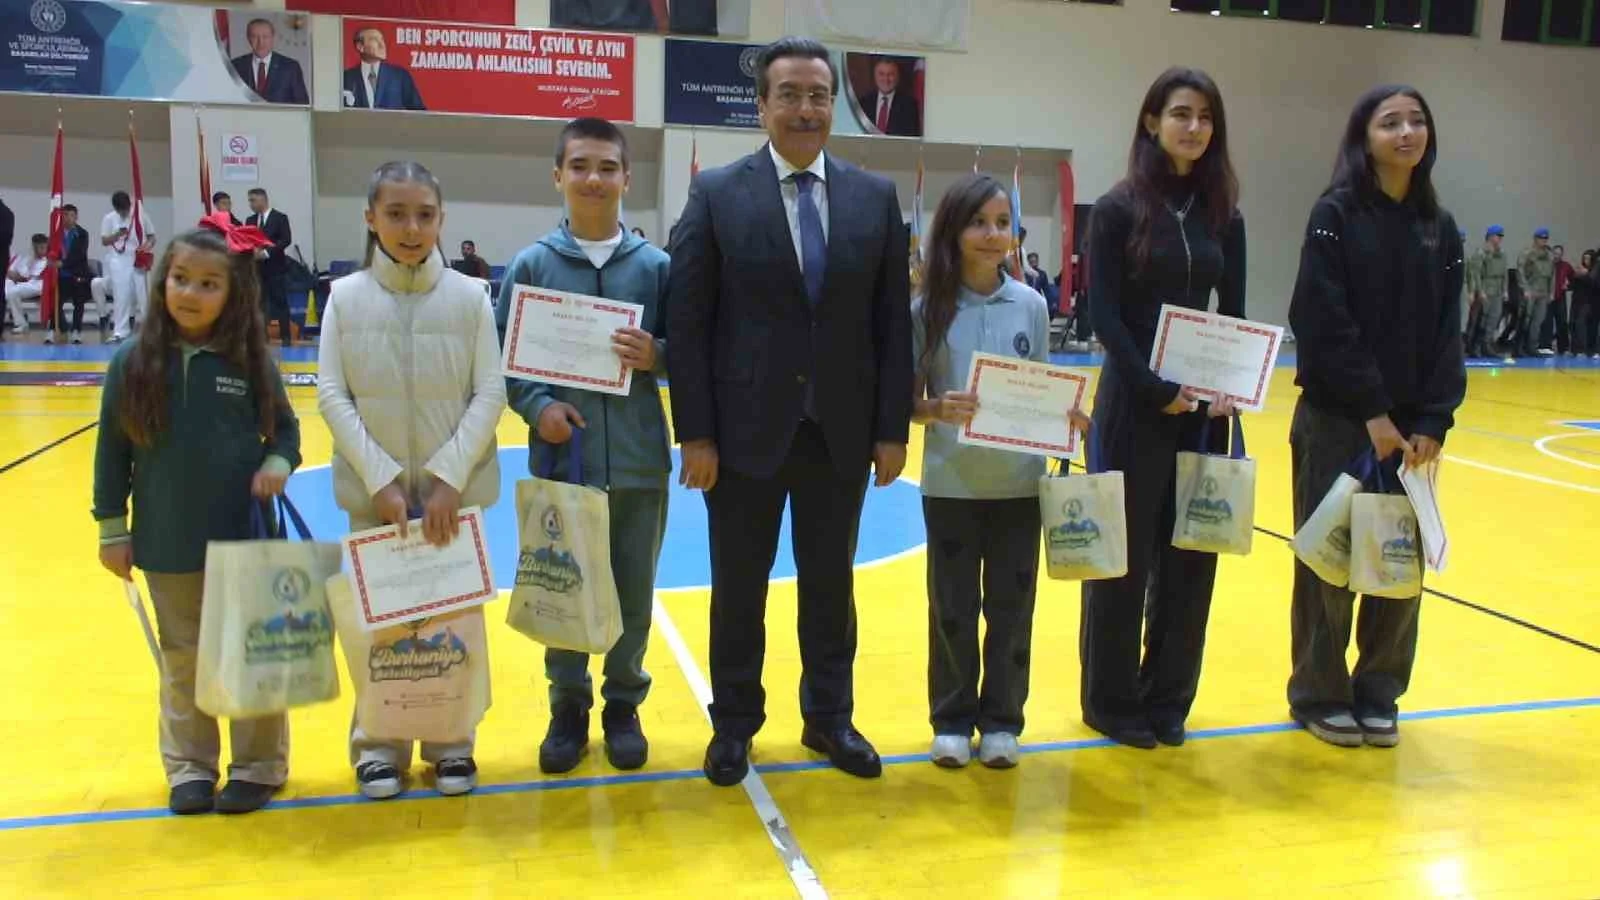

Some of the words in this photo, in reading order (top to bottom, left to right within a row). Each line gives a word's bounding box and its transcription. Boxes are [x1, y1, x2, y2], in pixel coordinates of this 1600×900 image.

[396, 28, 421, 45] BEN
[424, 29, 501, 48] SPORCUNUN
[504, 31, 536, 54] ZEKİ,
[540, 32, 575, 56] ÇEVİK
[578, 39, 593, 56] VE
[596, 40, 625, 58] AYNI
[410, 50, 473, 69] ZAMANDA
[476, 54, 552, 75] AHLAKLISINI
[556, 58, 612, 79] SEVERİM.
[681, 83, 700, 91] TÜM
[701, 84, 743, 95] ANTRENÖR
[370, 646, 464, 669] Burhaniye
